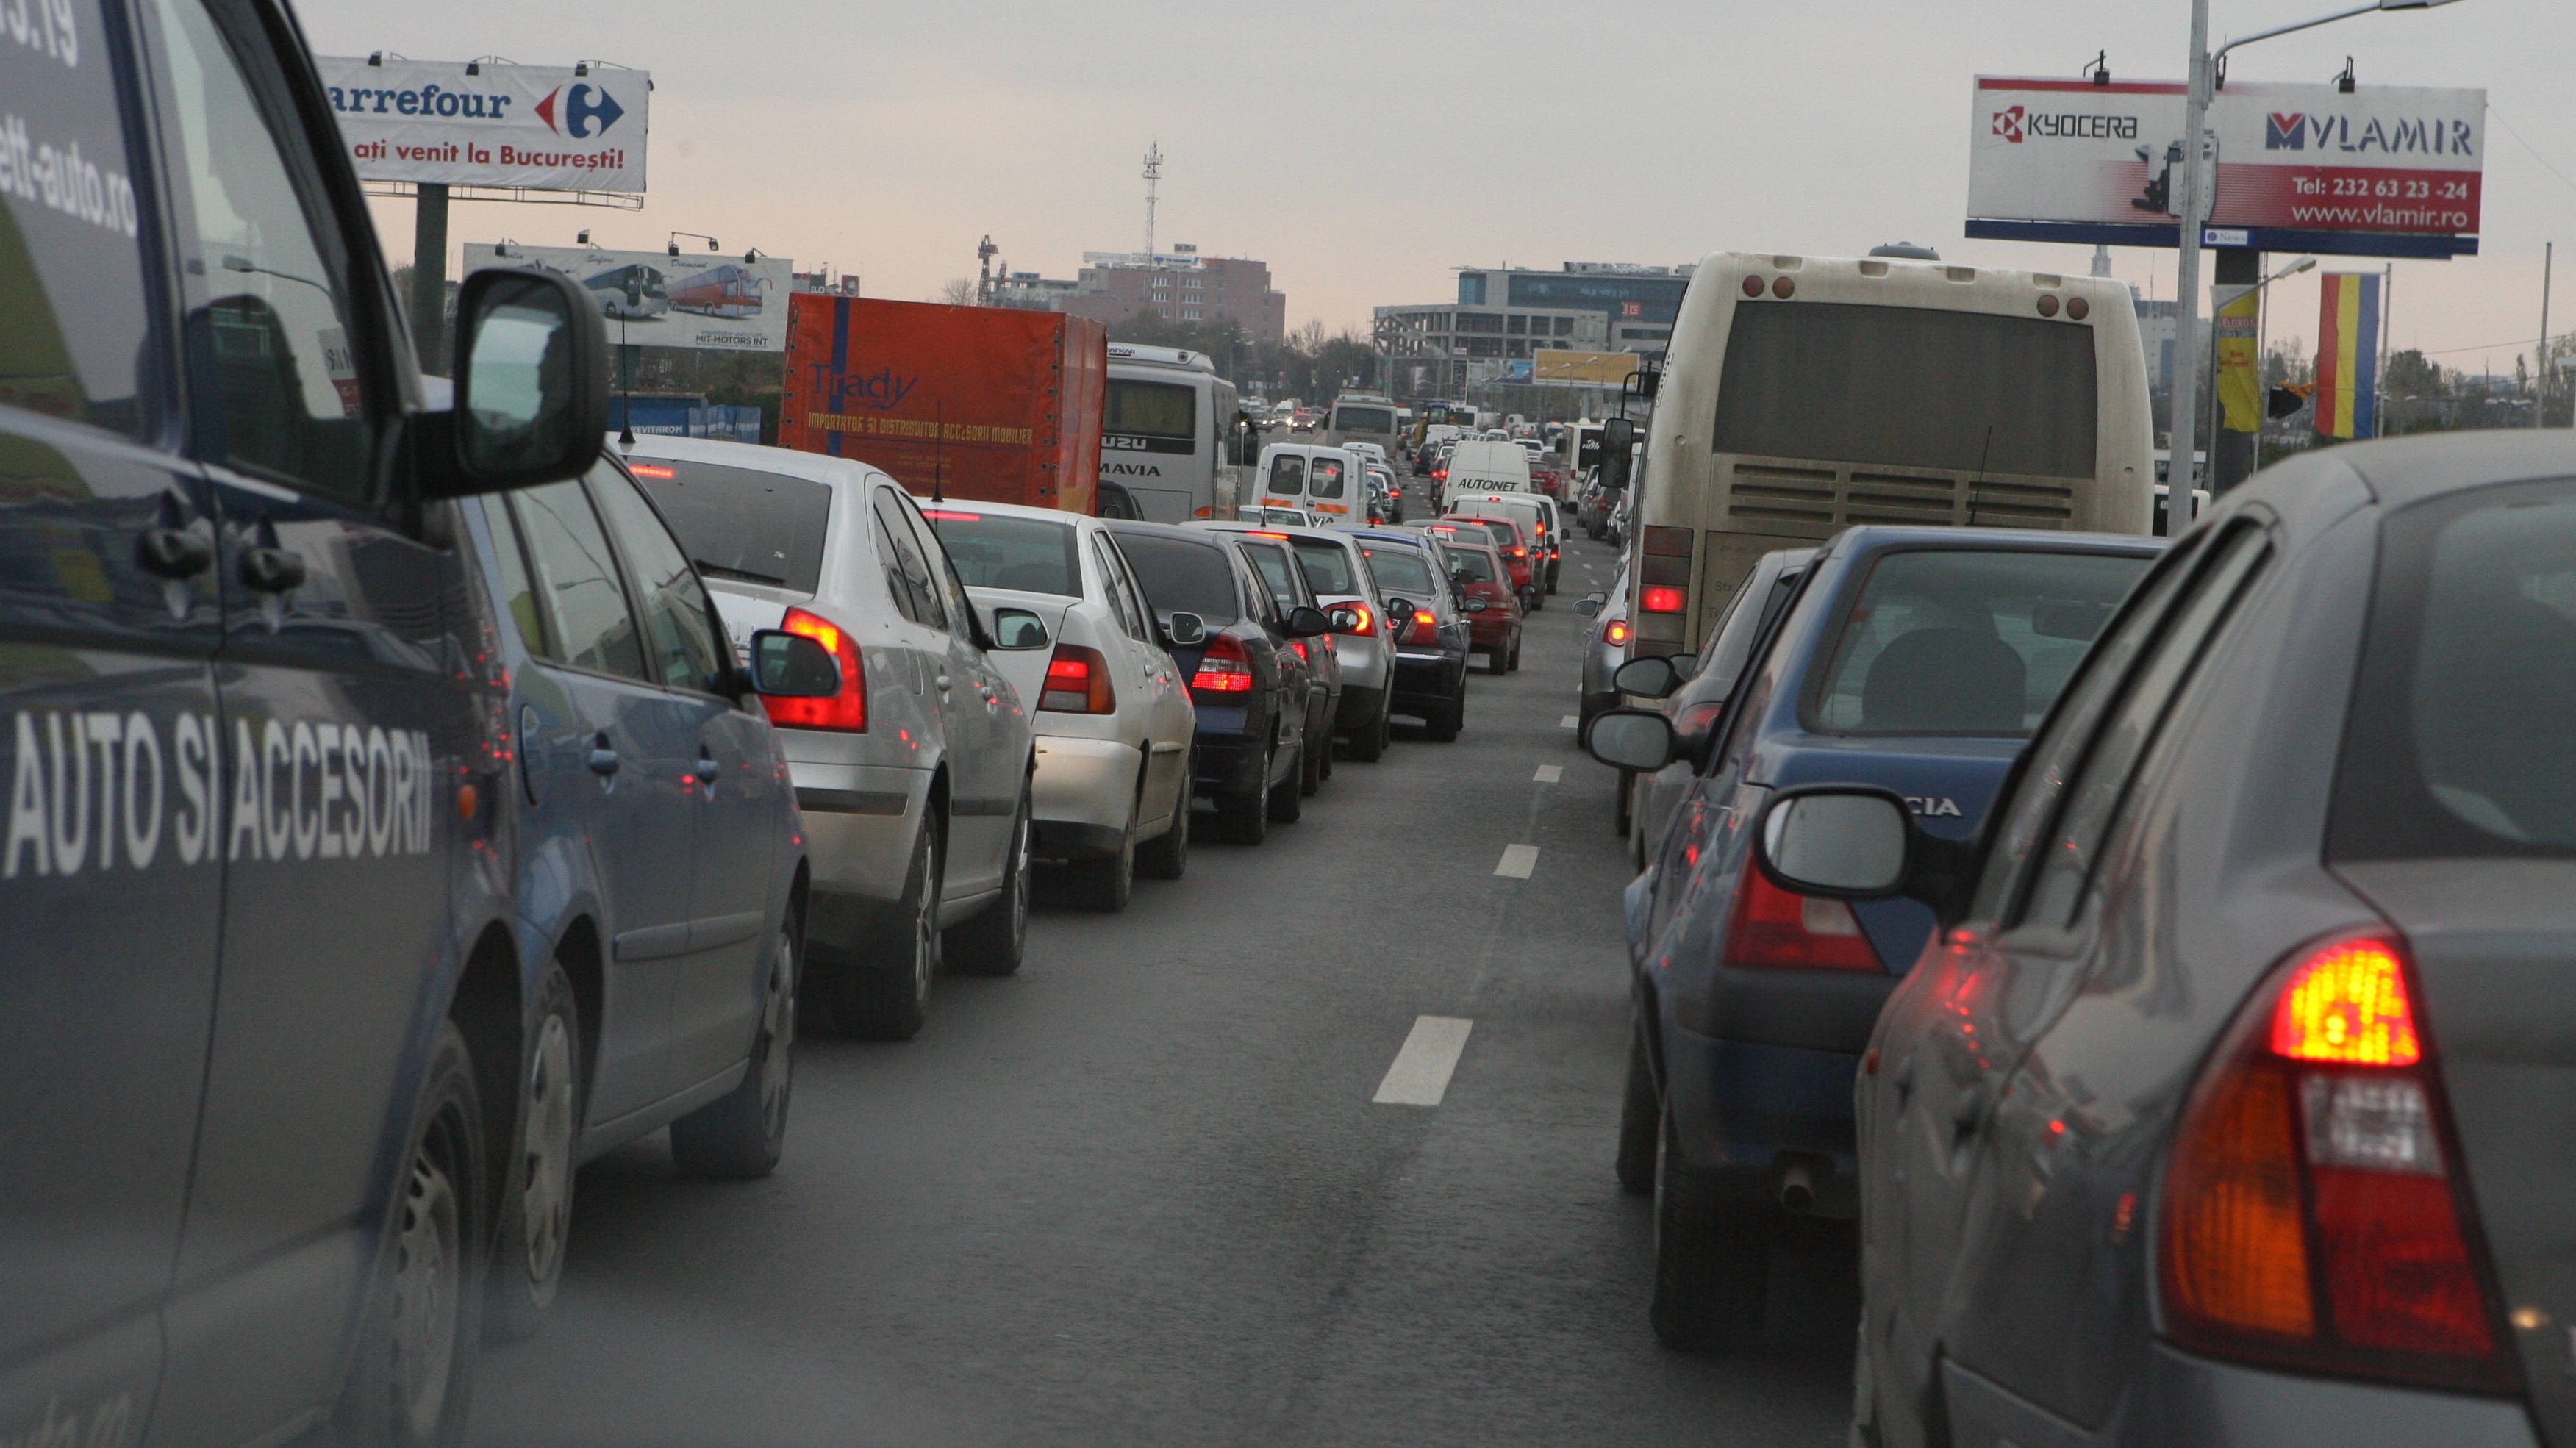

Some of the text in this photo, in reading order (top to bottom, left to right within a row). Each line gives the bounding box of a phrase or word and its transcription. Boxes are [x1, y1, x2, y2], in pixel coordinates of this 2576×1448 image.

[2028, 114, 2137, 138] KYOCERA
[2309, 114, 2473, 156] VLAMIR
[396, 142, 459, 162] venit
[468, 143, 490, 164] la
[2292, 177, 2468, 200] Tel: 232 63 23 -24
[2292, 203, 2468, 228] www.vlamir.ro
[992, 426, 1033, 445] MOBILIER
[1457, 479, 1518, 492] AUTONET
[3, 710, 432, 879] AUTO SI ACCESORII
